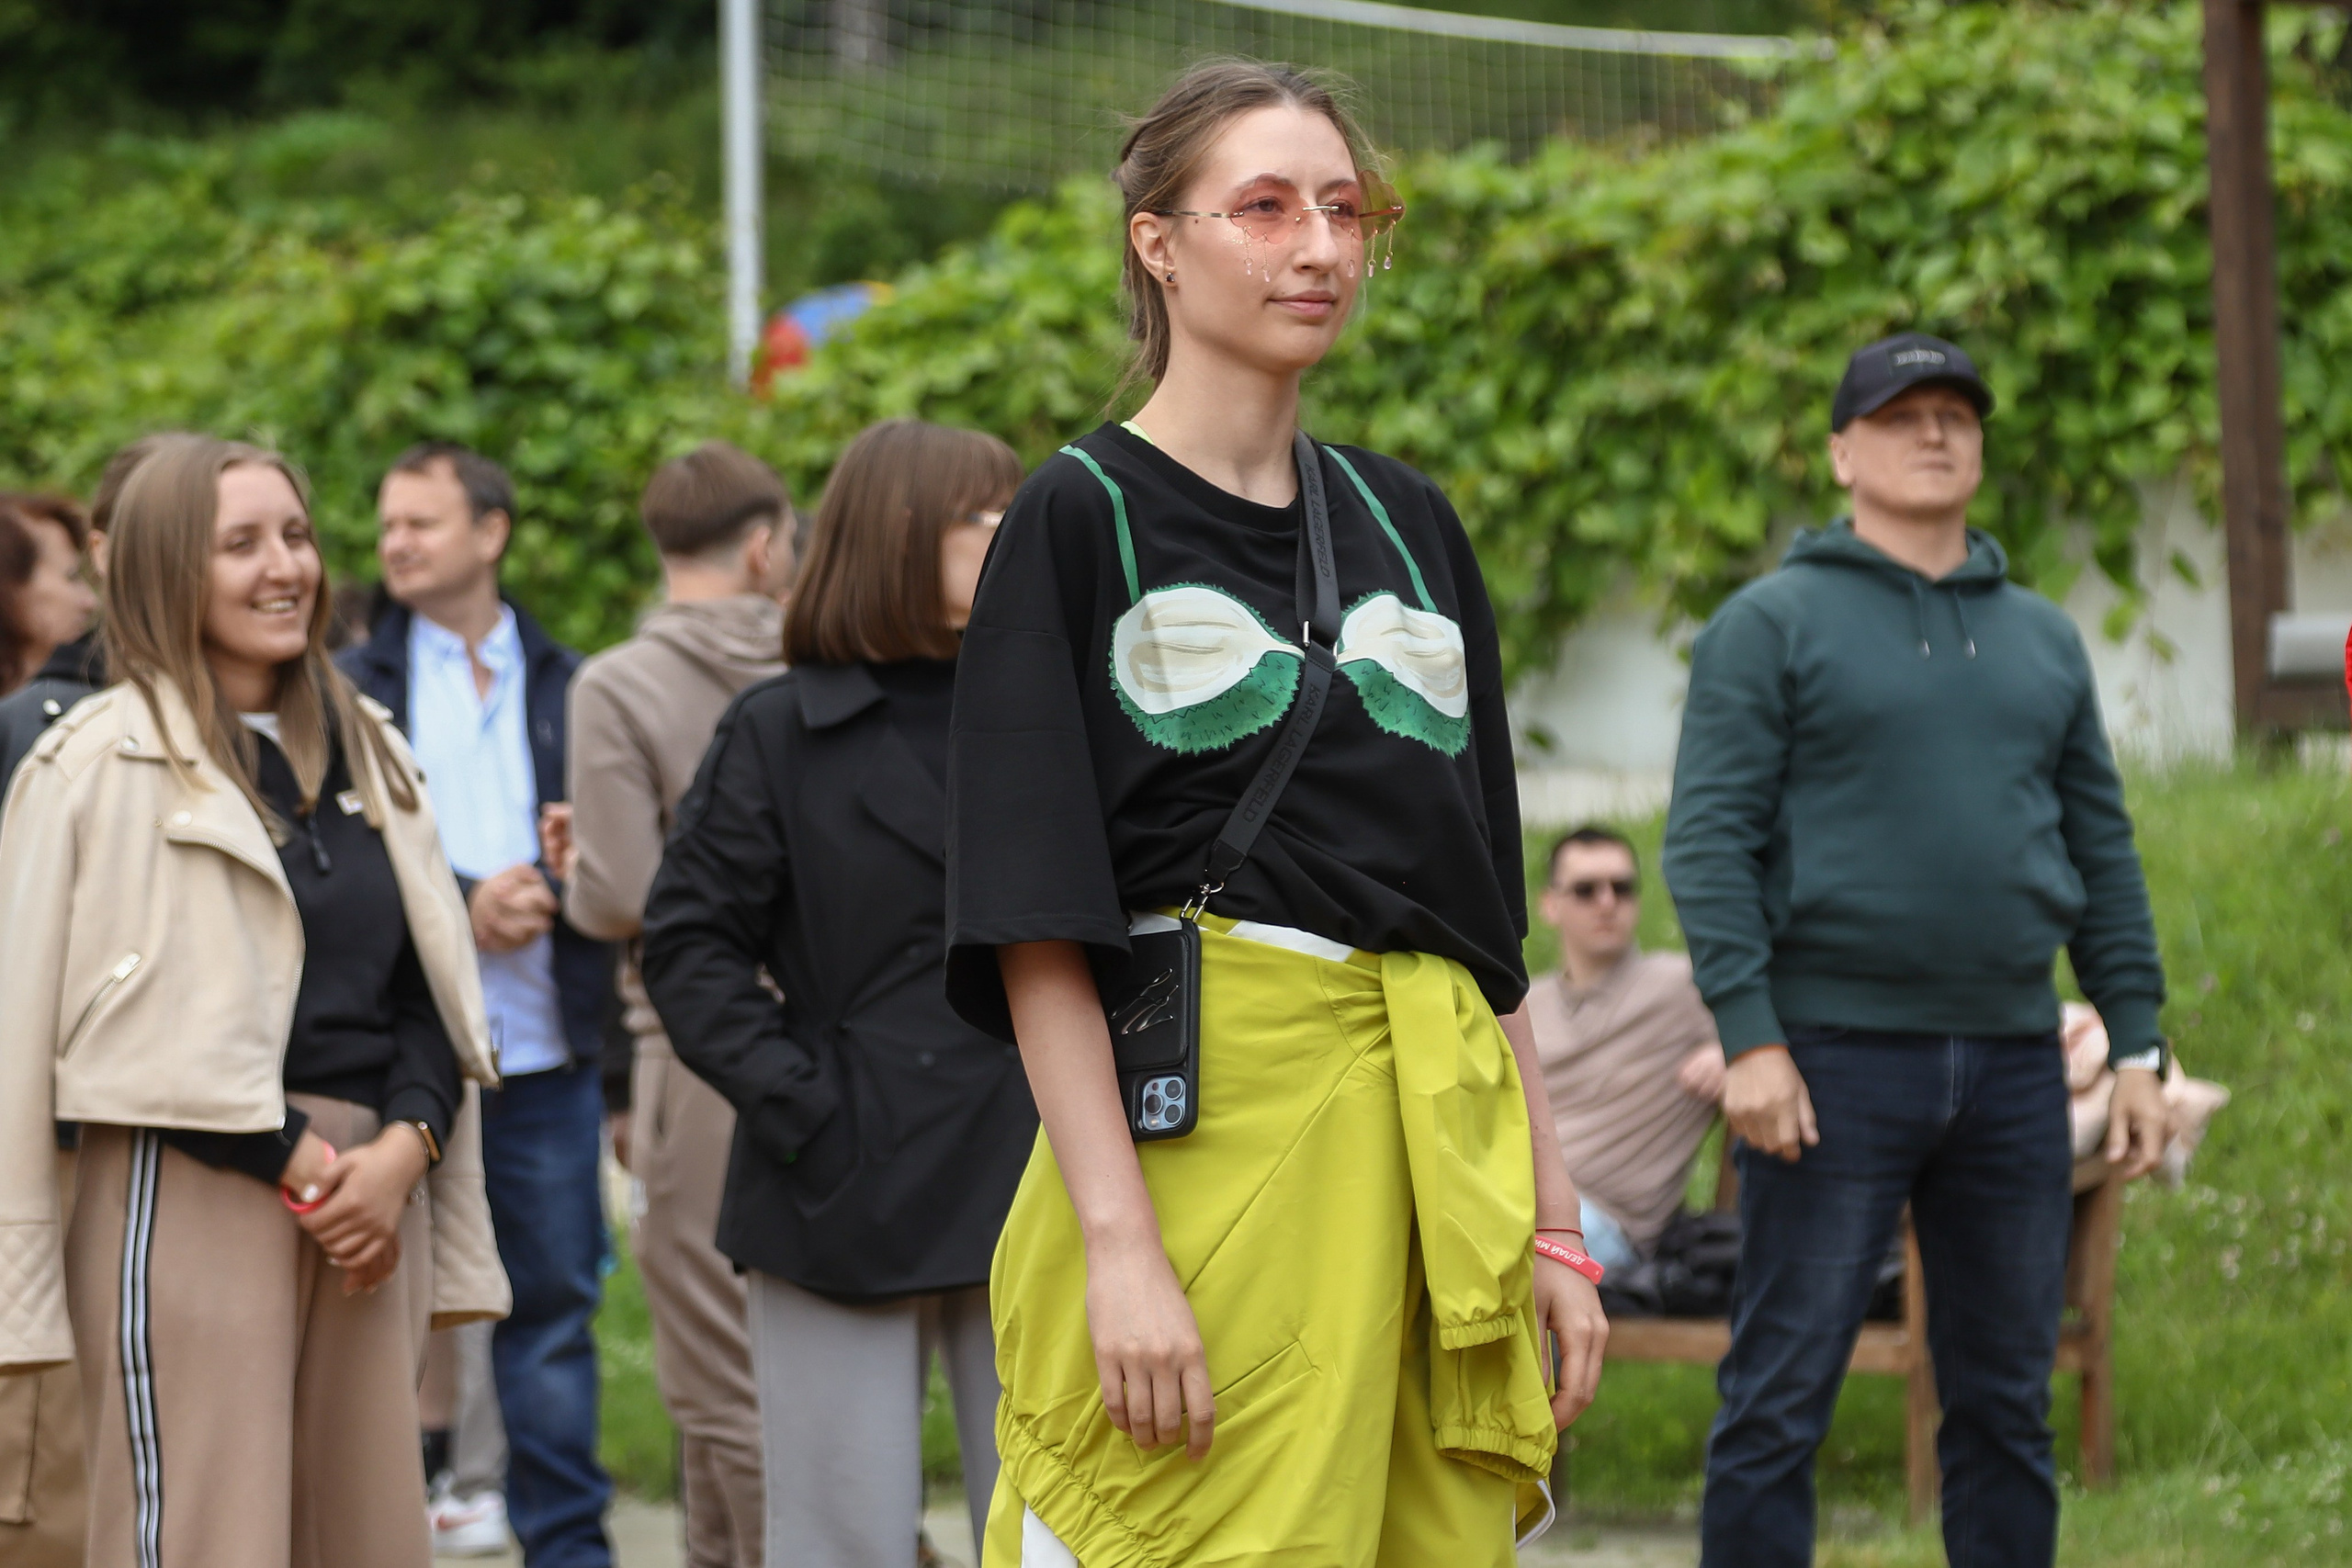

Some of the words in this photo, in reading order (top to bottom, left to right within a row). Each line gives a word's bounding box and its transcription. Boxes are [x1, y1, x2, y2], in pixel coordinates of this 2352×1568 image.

[1305, 462, 1320, 497] KARL
[1310, 498, 1331, 579] LAGERFELD
[1296, 682, 1320, 725] KARL
[1242, 729, 1302, 823] LAGERFELD
[1550, 1245, 1586, 1266] ДЕЛАЙ
